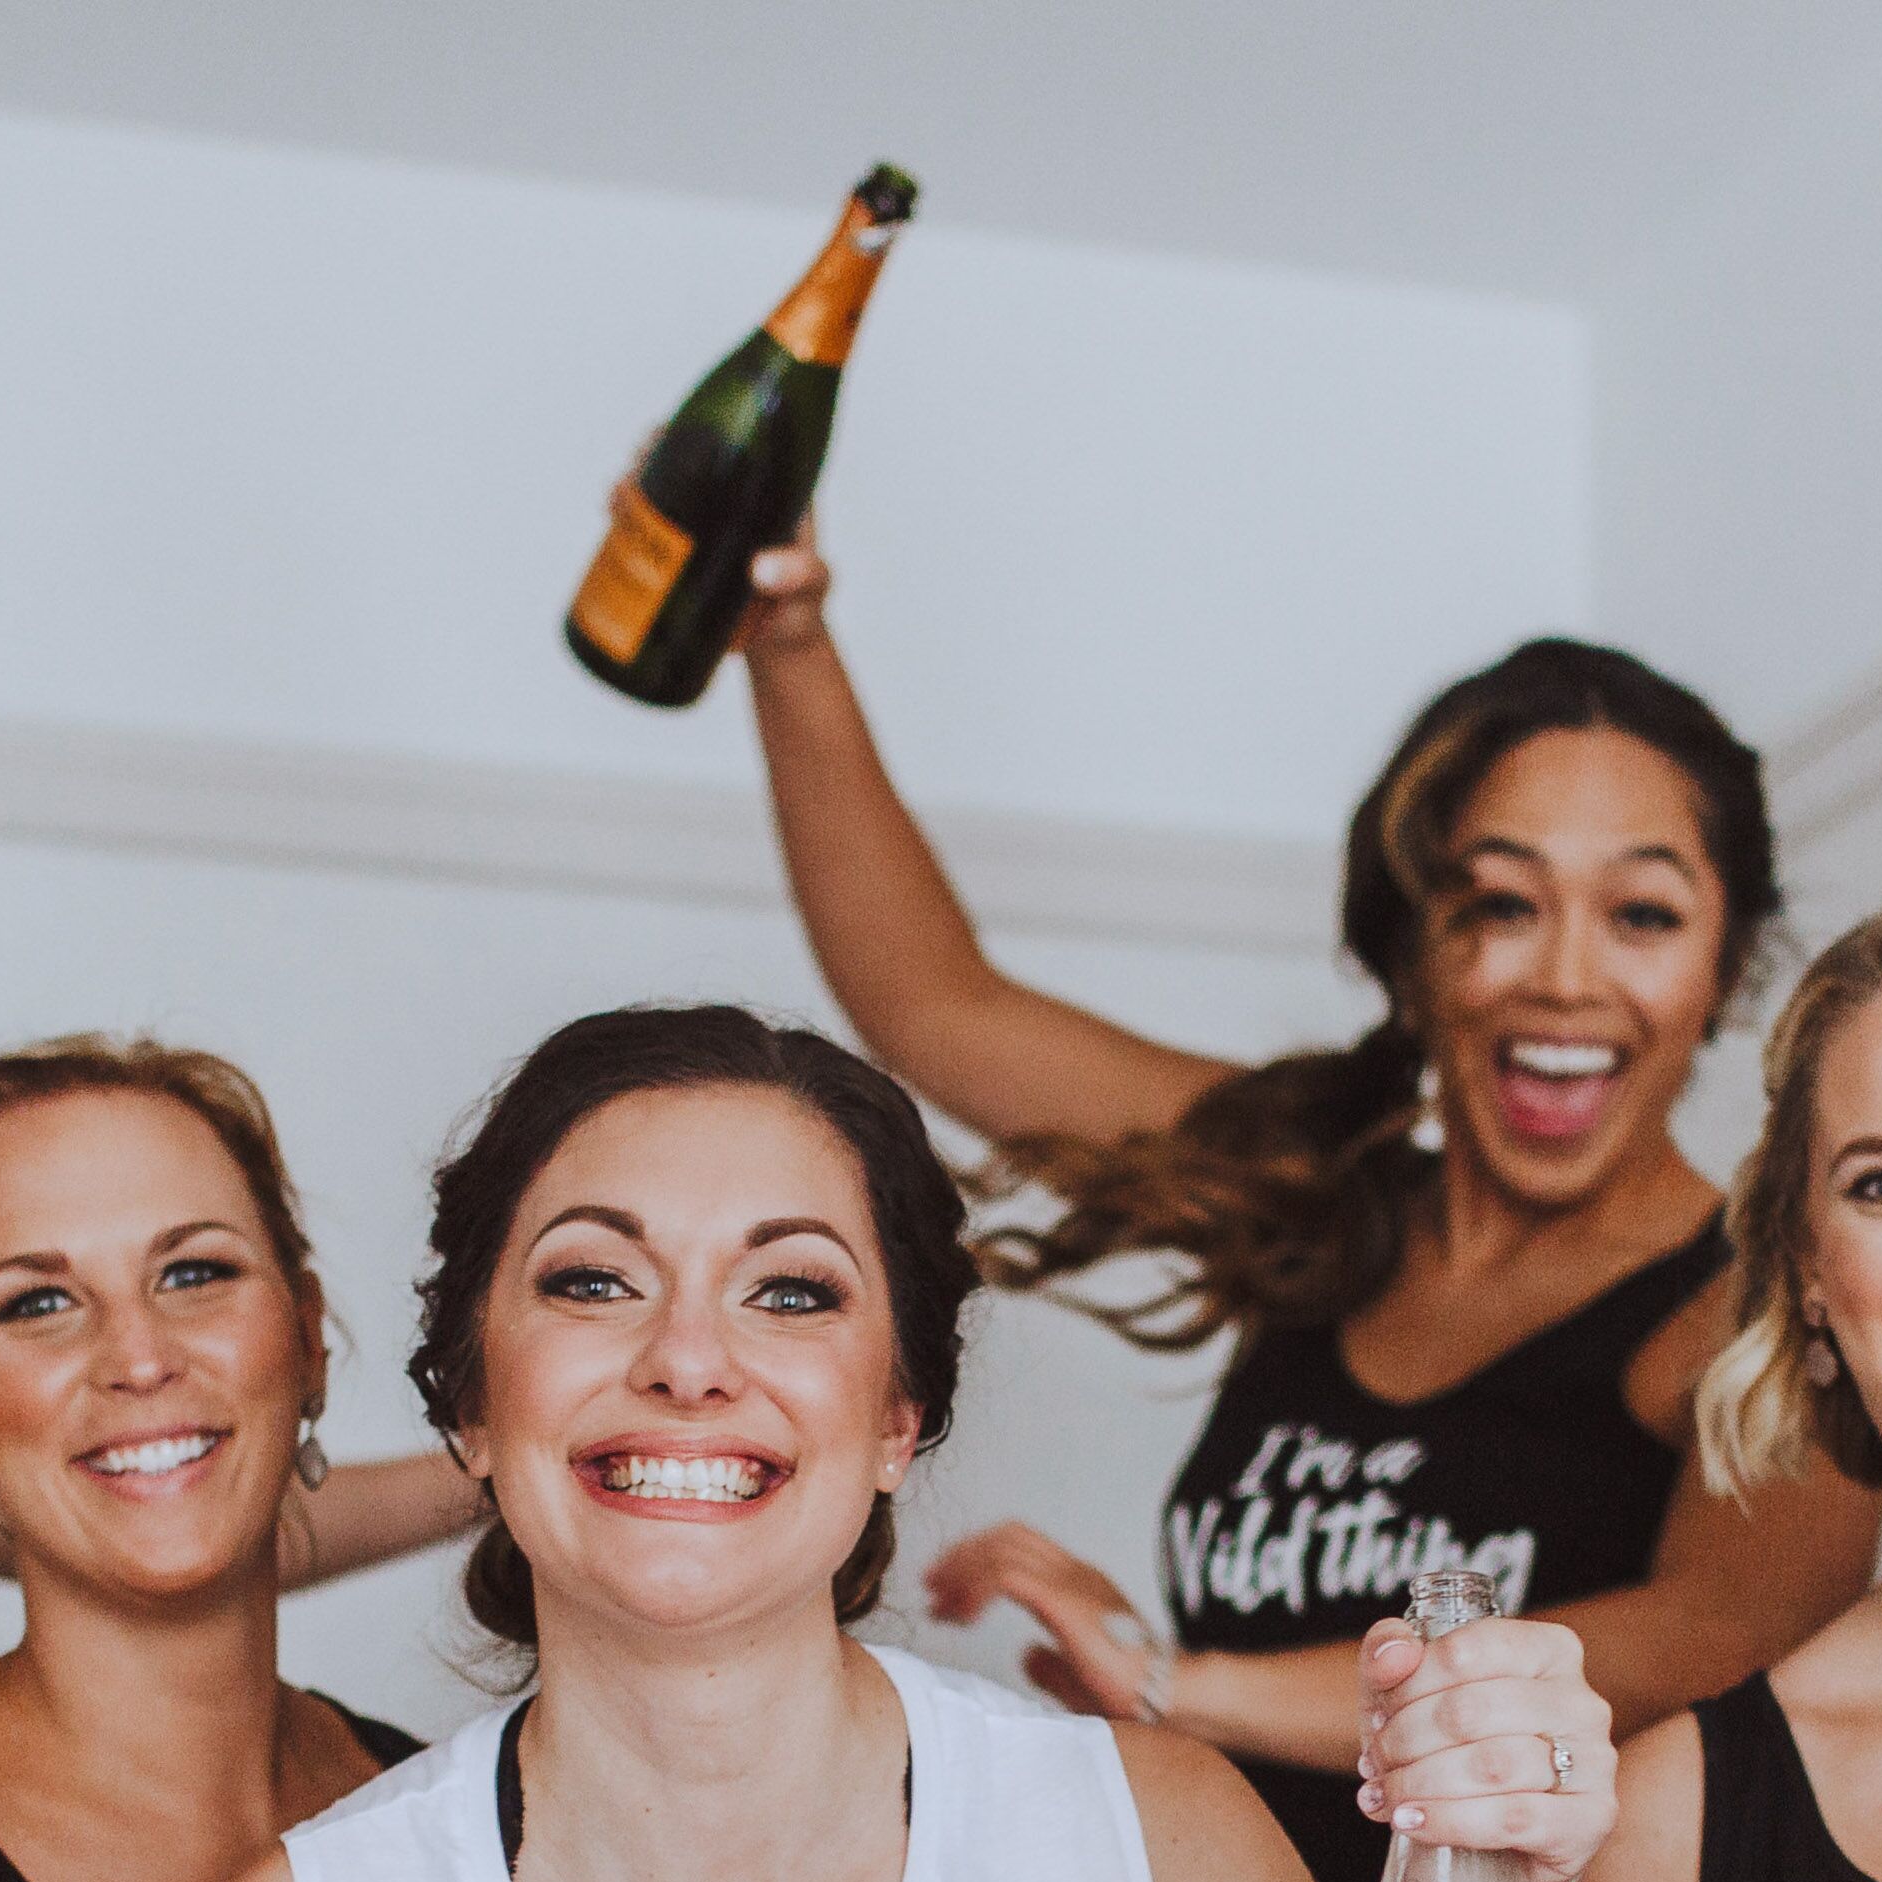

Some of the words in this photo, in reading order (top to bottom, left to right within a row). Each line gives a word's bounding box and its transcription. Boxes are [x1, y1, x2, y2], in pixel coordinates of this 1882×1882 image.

[1362, 1437, 1425, 1485] a
[1172, 1496, 1321, 1616] Wild
[1315, 1488, 1537, 1617] thing
